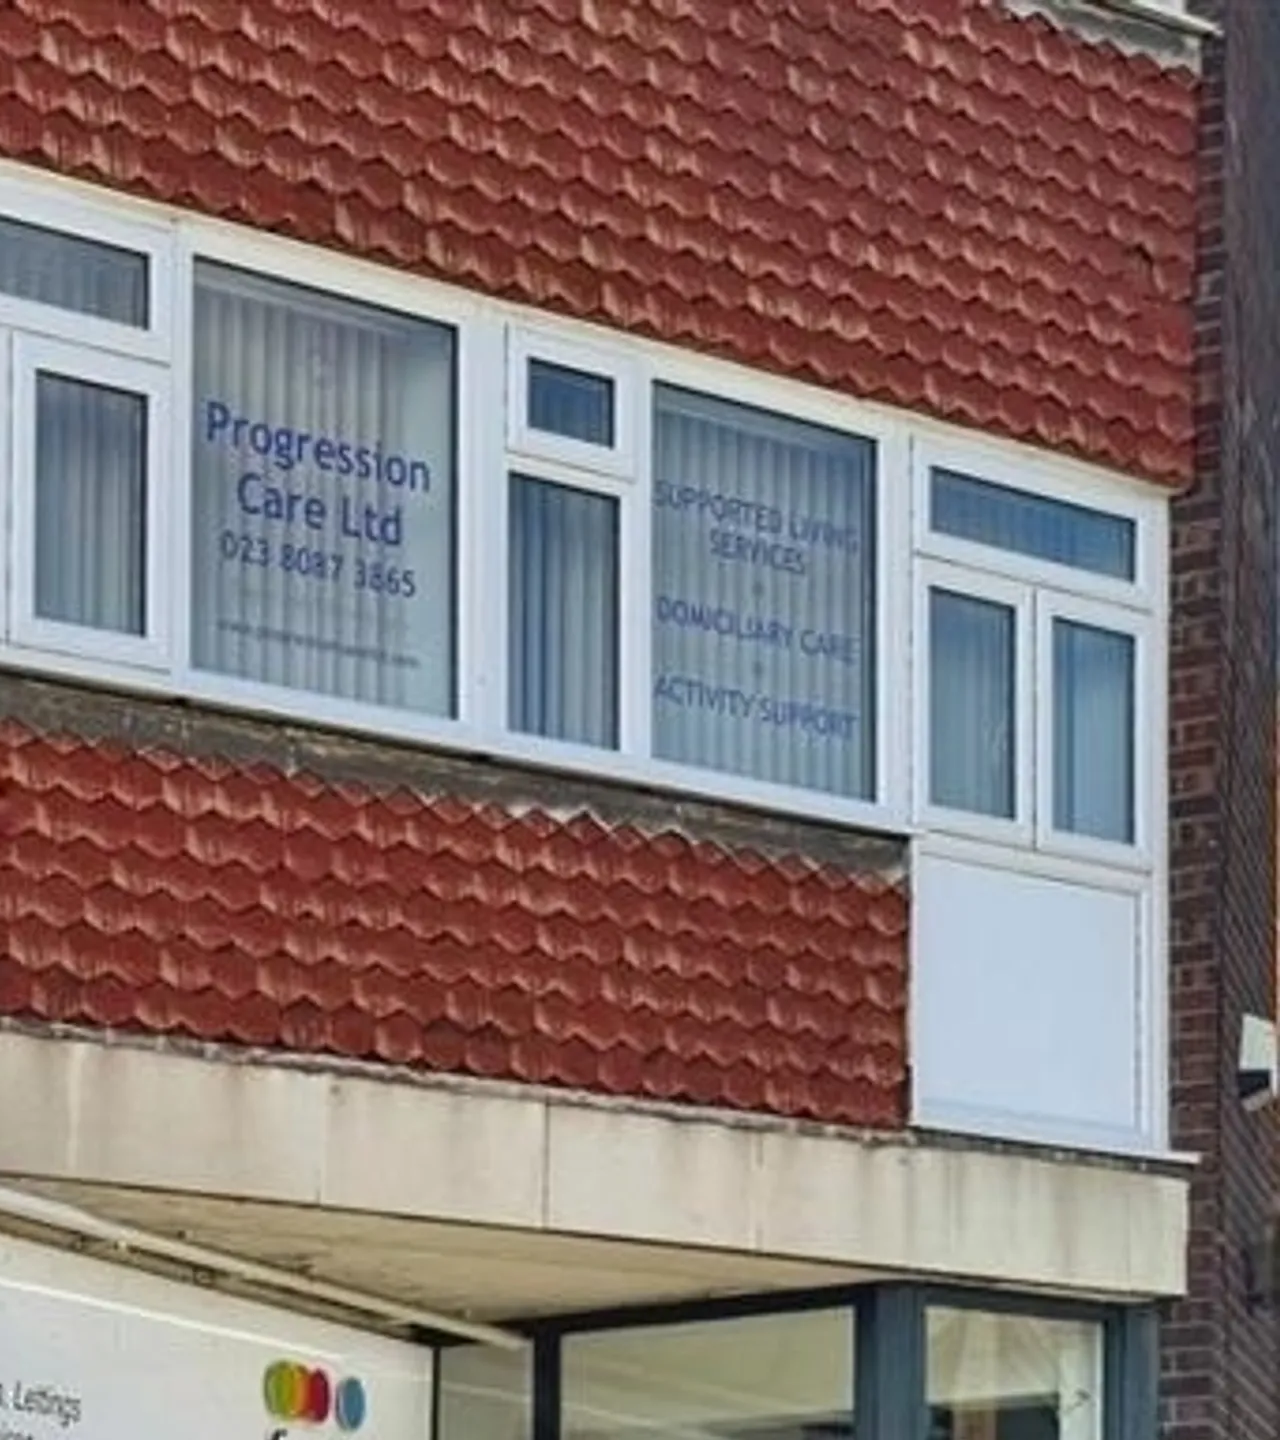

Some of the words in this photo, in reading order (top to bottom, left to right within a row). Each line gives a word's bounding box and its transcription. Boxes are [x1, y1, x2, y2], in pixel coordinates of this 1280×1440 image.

[205, 400, 431, 492] Progression
[236, 472, 327, 530] Care
[341, 496, 403, 546] Ltd
[219, 529, 269, 567] 023
[653, 674, 753, 718] ACTIVITY
[12, 1379, 82, 1428] Lettings
